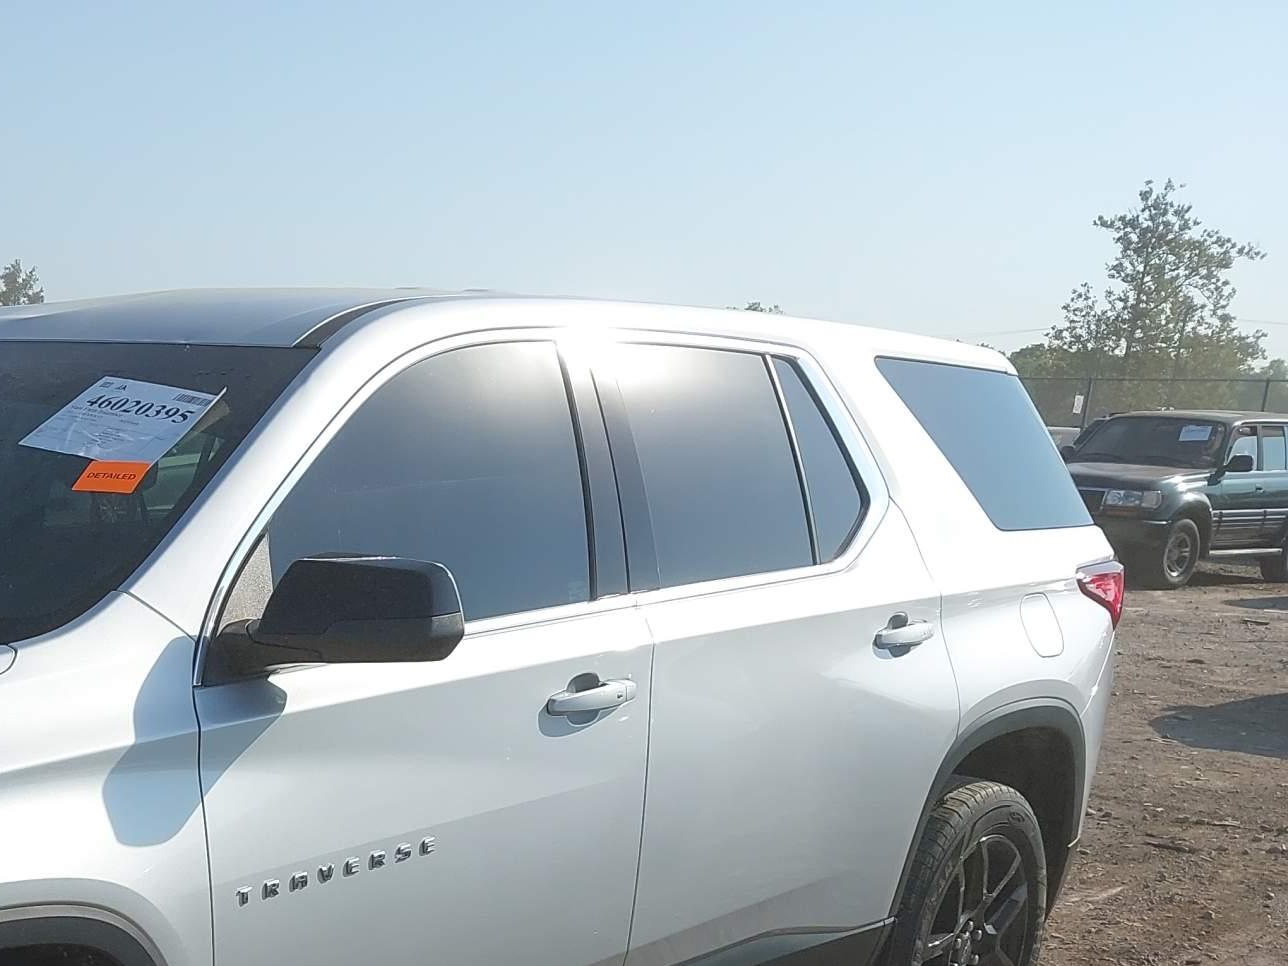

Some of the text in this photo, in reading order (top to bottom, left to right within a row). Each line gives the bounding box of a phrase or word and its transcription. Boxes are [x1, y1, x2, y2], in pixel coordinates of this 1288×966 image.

[86, 393, 196, 424] 46020395
[86, 471, 137, 481] DETAILED
[235, 836, 436, 907] TRAVERSE
